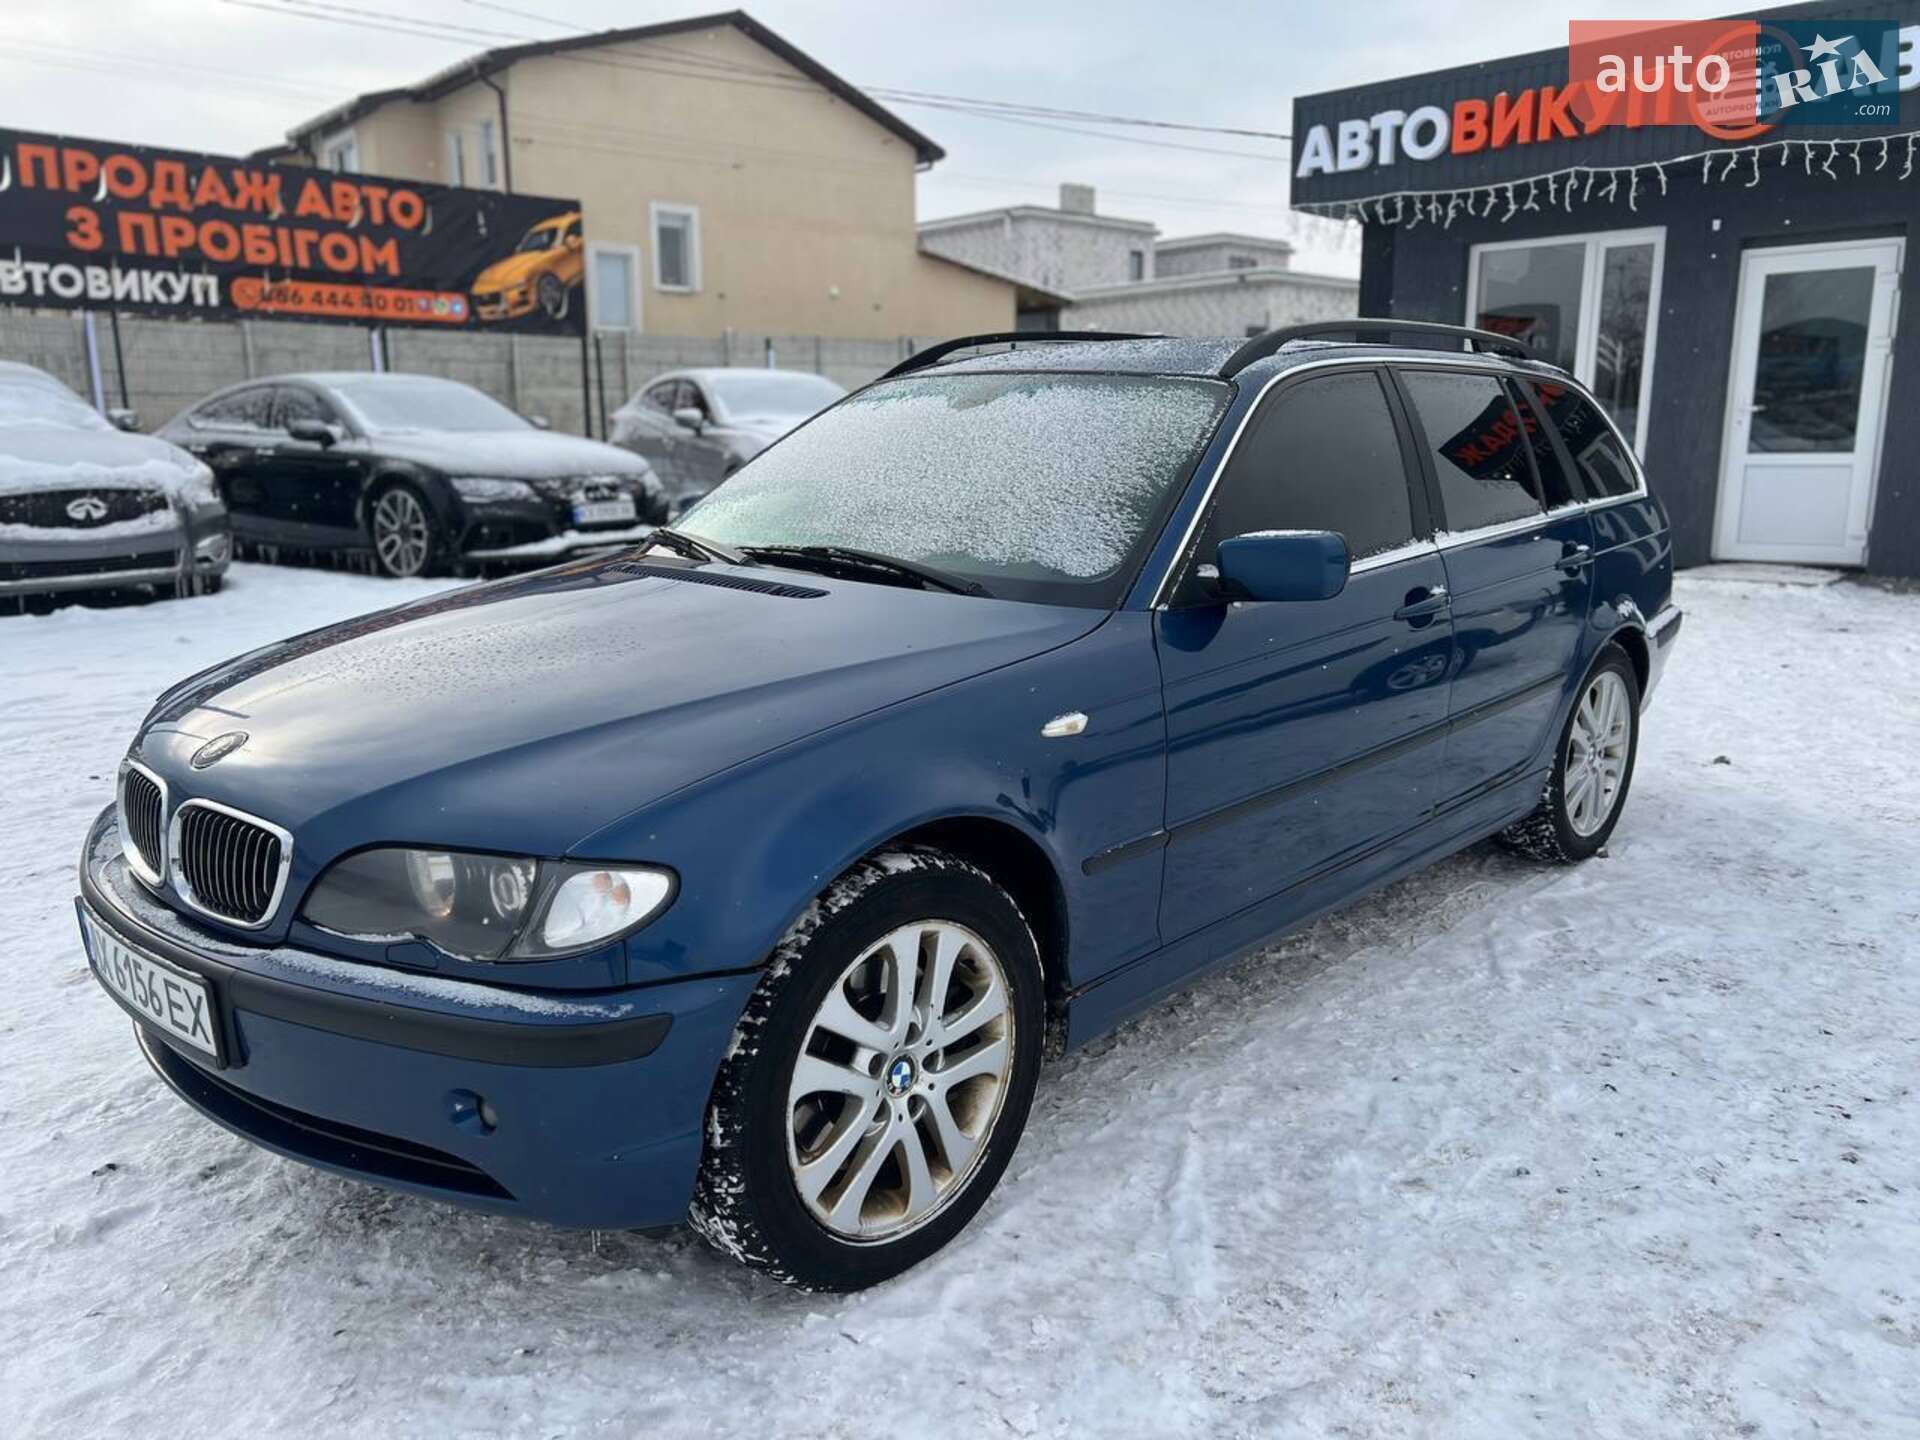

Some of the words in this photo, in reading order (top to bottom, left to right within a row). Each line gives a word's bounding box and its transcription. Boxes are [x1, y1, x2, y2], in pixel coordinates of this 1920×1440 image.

[1296, 66, 1673, 178] АВТОВИКУП
[16, 142, 285, 216] ПРОДАЖ
[295, 176, 426, 231] АВТО
[0, 258, 220, 307] ВТОВИКУП
[116, 210, 400, 277] ПРОБІГОМ
[311, 289, 355, 308] 444
[113, 945, 163, 1018] 6156
[162, 976, 212, 1046] EX
